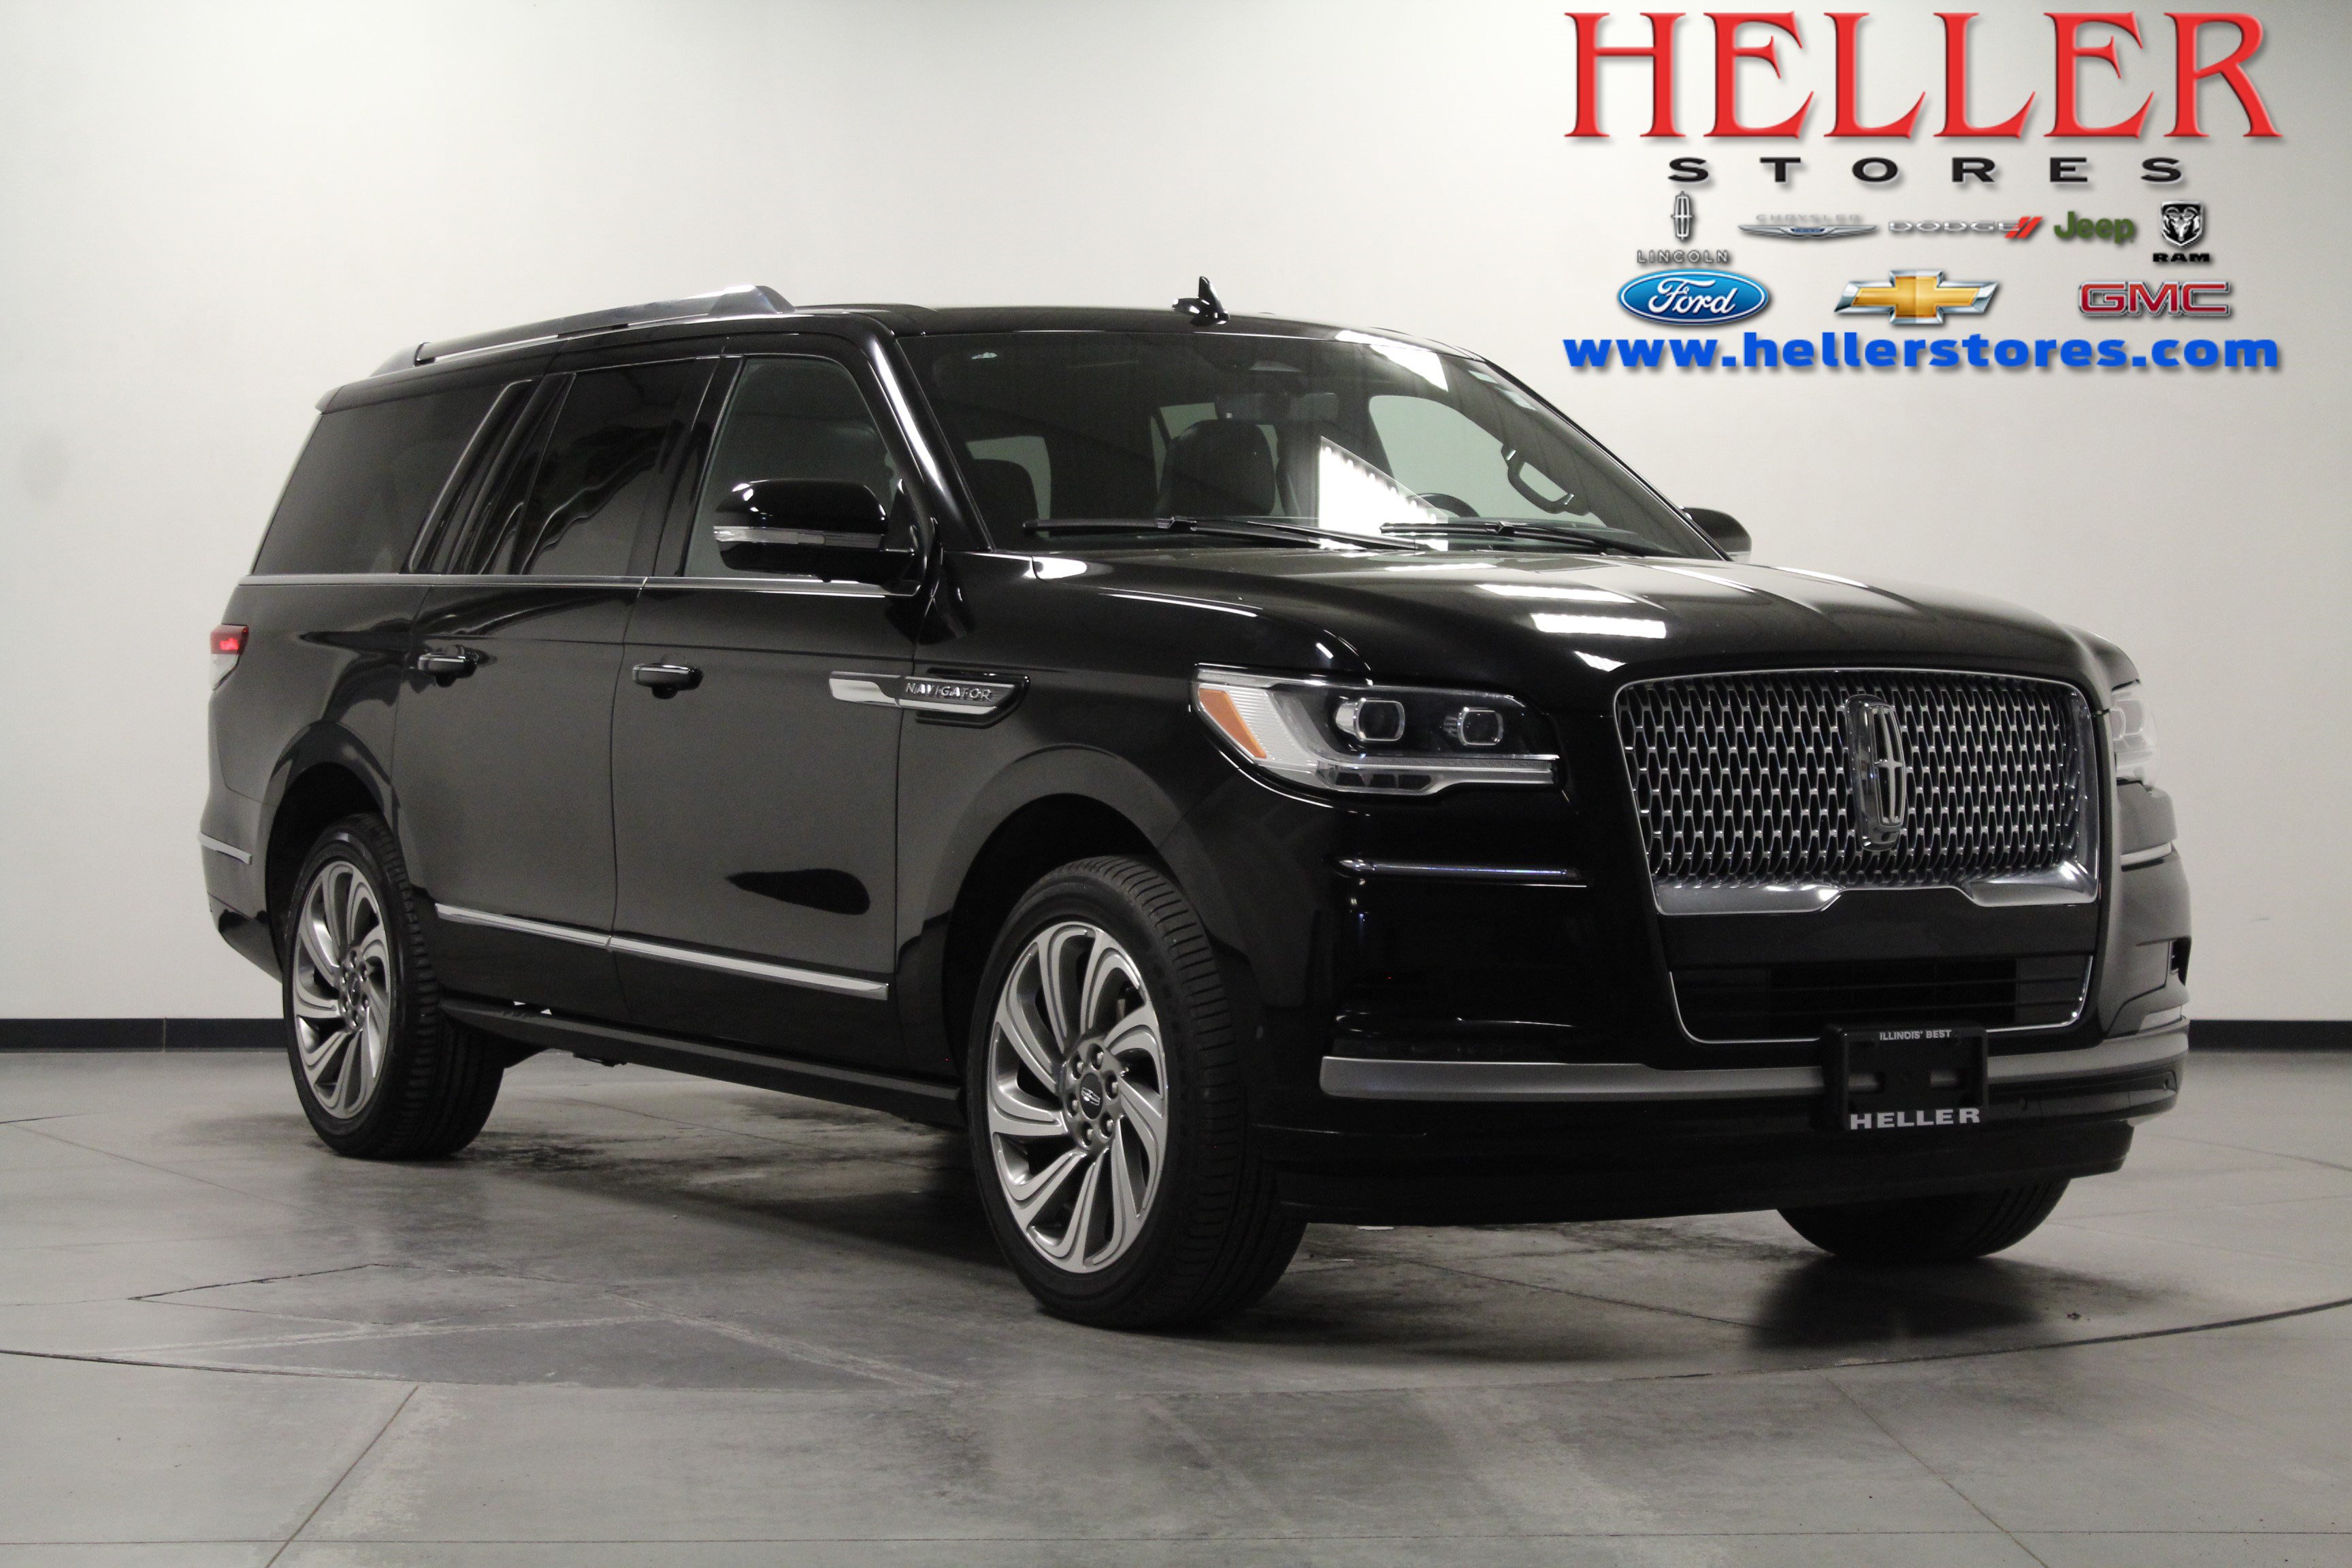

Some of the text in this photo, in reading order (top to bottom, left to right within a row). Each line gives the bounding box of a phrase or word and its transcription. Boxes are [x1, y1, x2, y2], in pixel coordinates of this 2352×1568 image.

[906, 683, 992, 702] NAVIGATOR
[1879, 1029, 1952, 1041] ILLINOIS' BEST
[1850, 1107, 1980, 1130] HELLER
